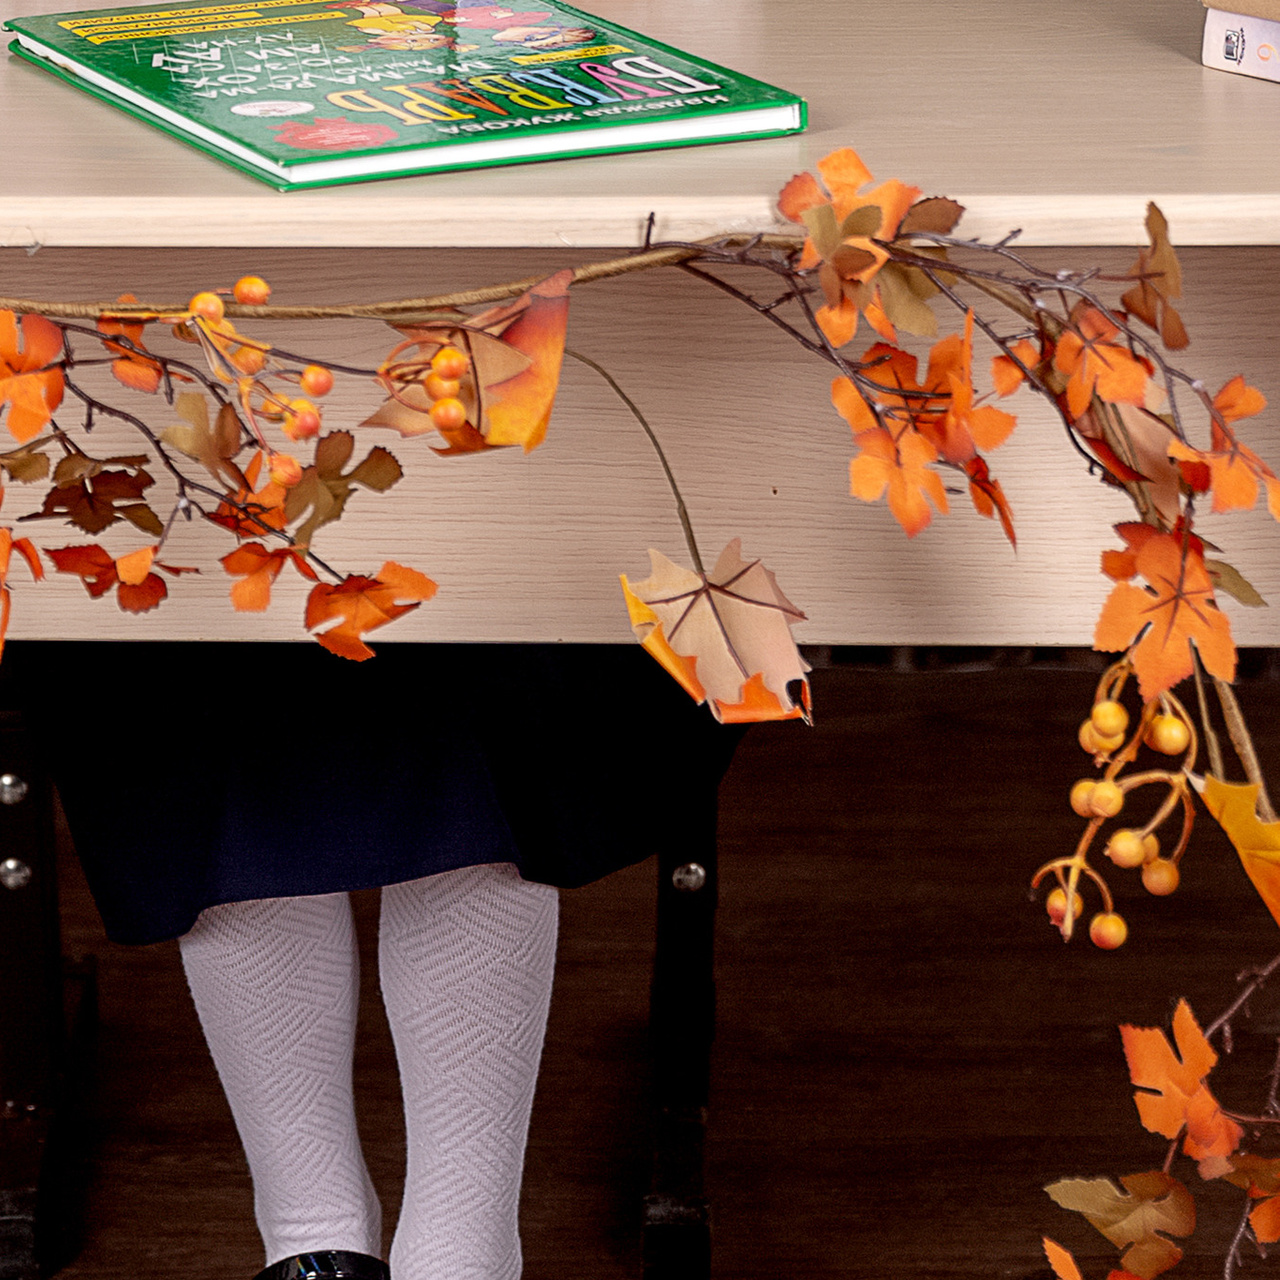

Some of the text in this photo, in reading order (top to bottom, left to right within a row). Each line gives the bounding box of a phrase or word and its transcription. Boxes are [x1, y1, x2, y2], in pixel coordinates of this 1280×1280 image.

[244, 43, 321, 60] АМ
[181, 73, 257, 88] ОХ
[326, 60, 497, 86] МА-МА
[326, 55, 721, 126] БУКВАРЬ
[437, 94, 730, 135] Надежда ЖУКОВА
